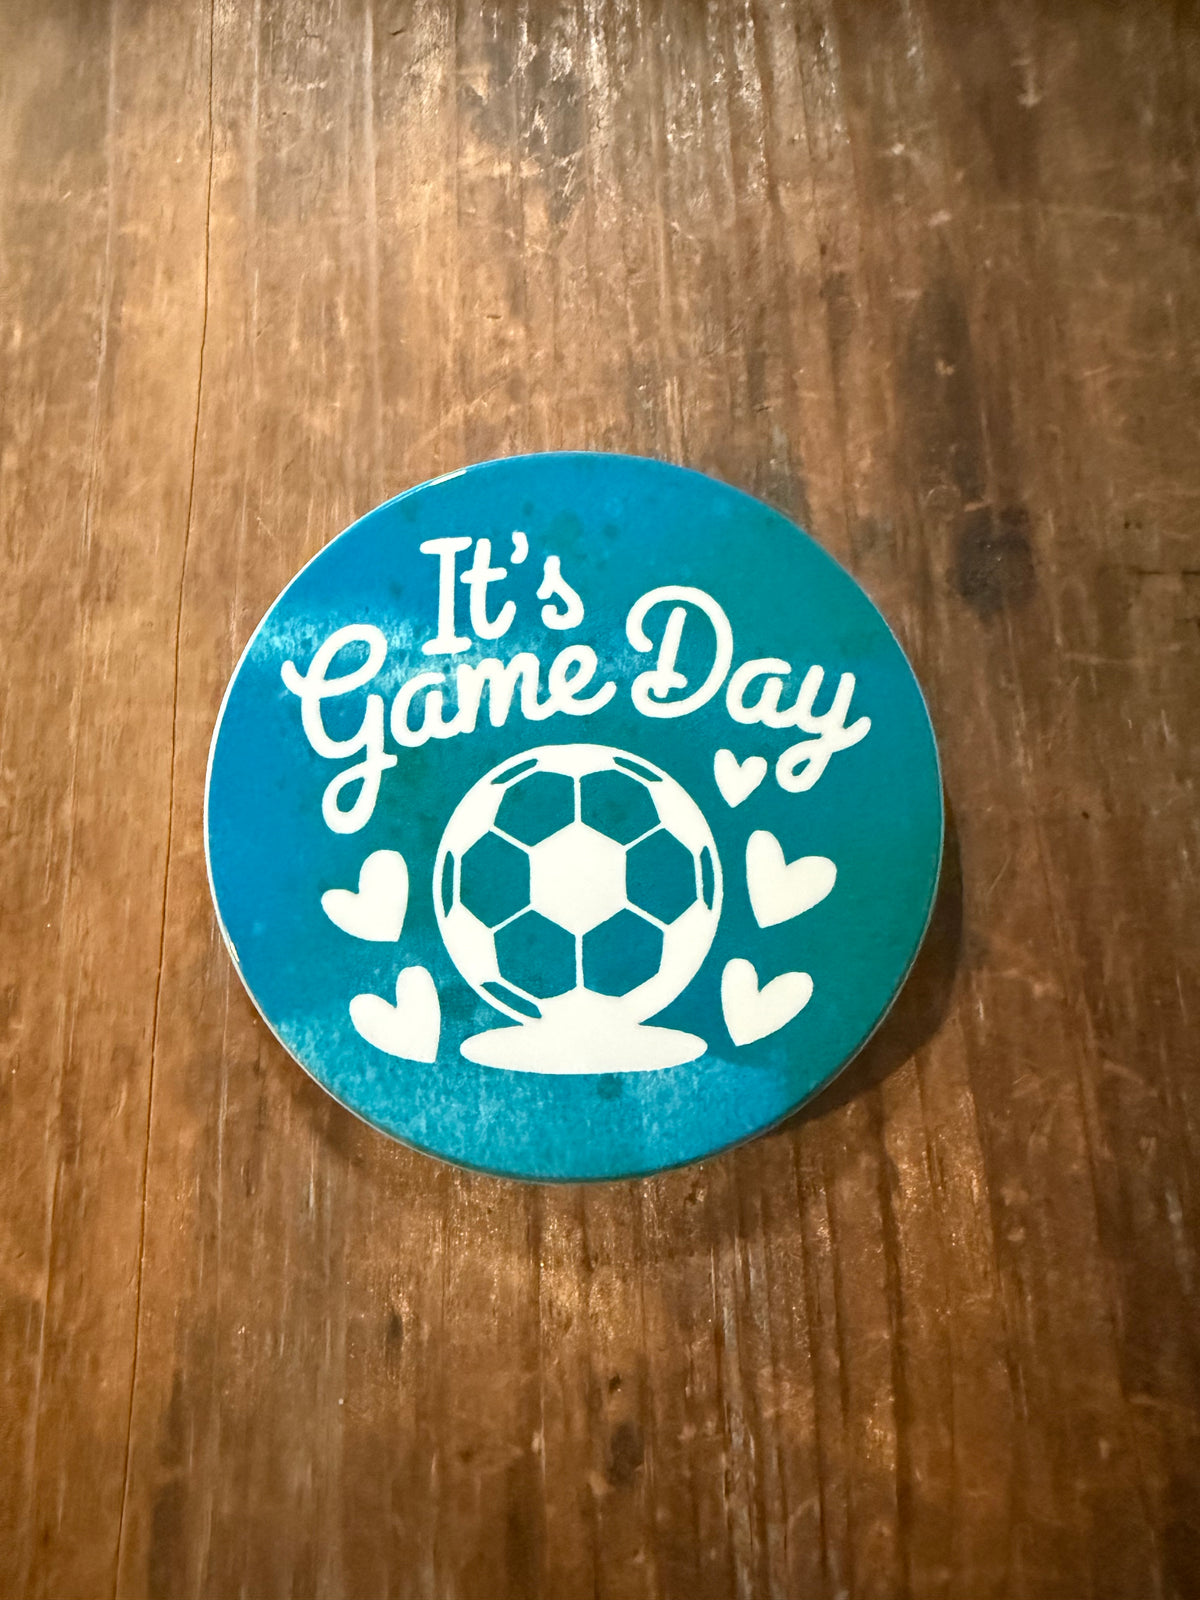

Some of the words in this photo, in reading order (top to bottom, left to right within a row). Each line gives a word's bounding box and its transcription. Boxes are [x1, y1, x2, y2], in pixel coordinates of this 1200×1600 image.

[419, 531, 584, 656] It's
[281, 623, 617, 835] Game
[625, 585, 871, 793] Day
